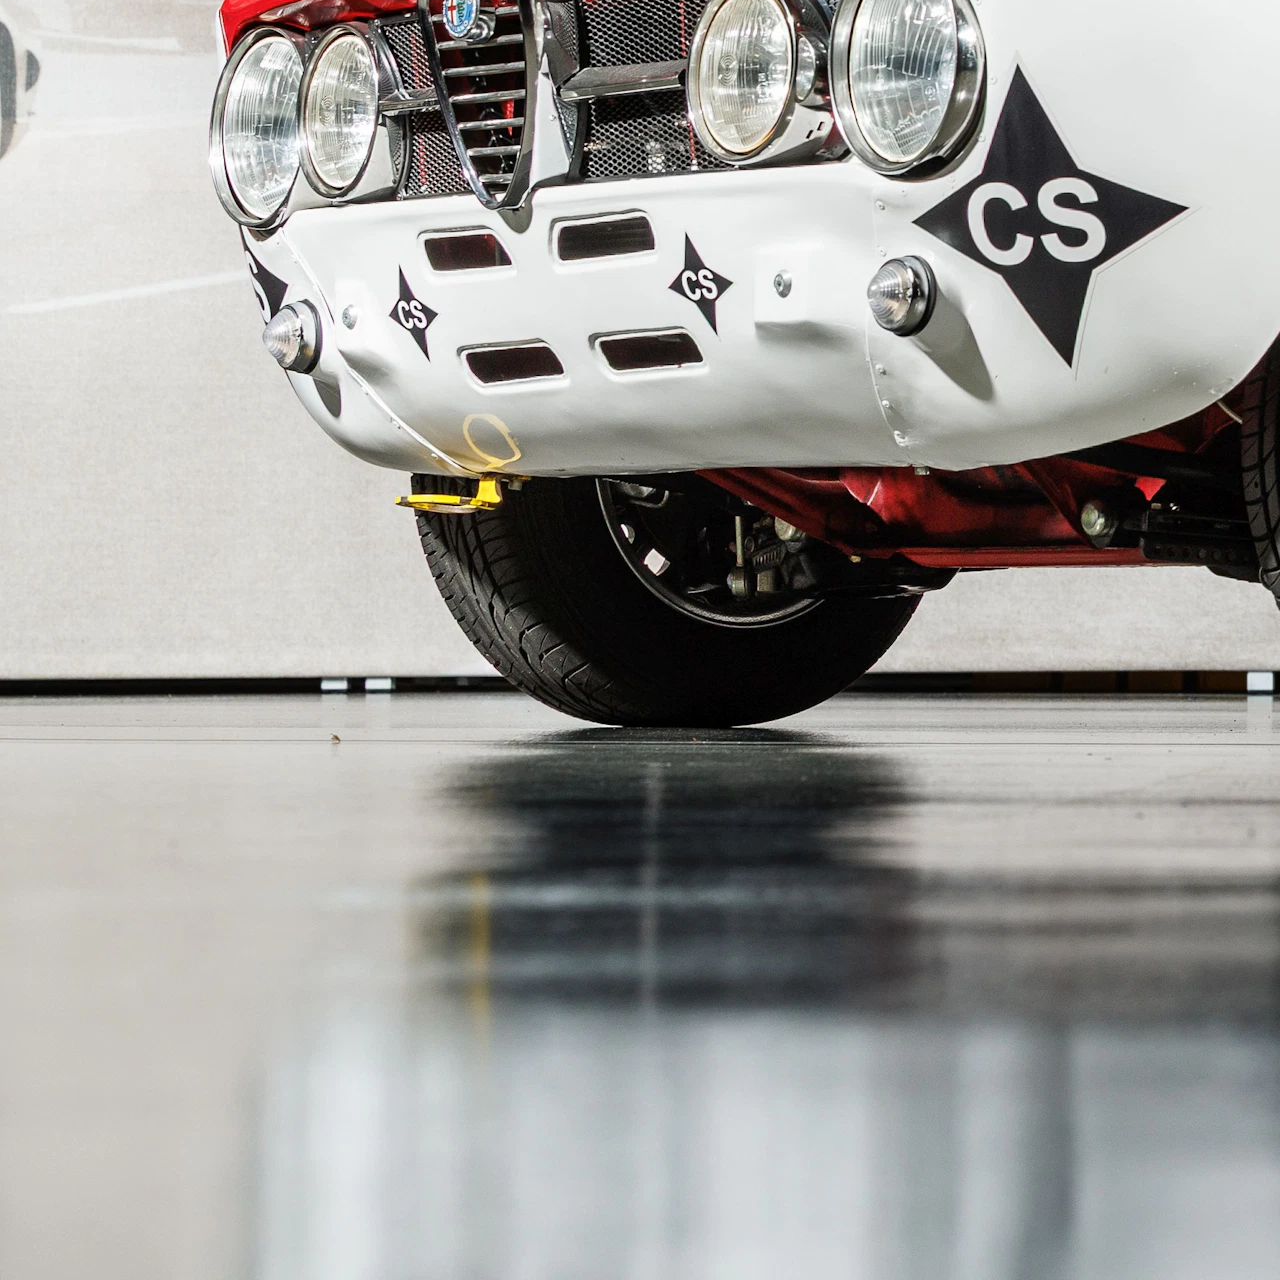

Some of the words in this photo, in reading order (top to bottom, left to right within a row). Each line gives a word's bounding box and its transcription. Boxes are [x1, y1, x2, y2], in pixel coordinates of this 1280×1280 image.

[967, 177, 1106, 265] CS
[681, 268, 719, 301] CS
[398, 299, 428, 329] CS
